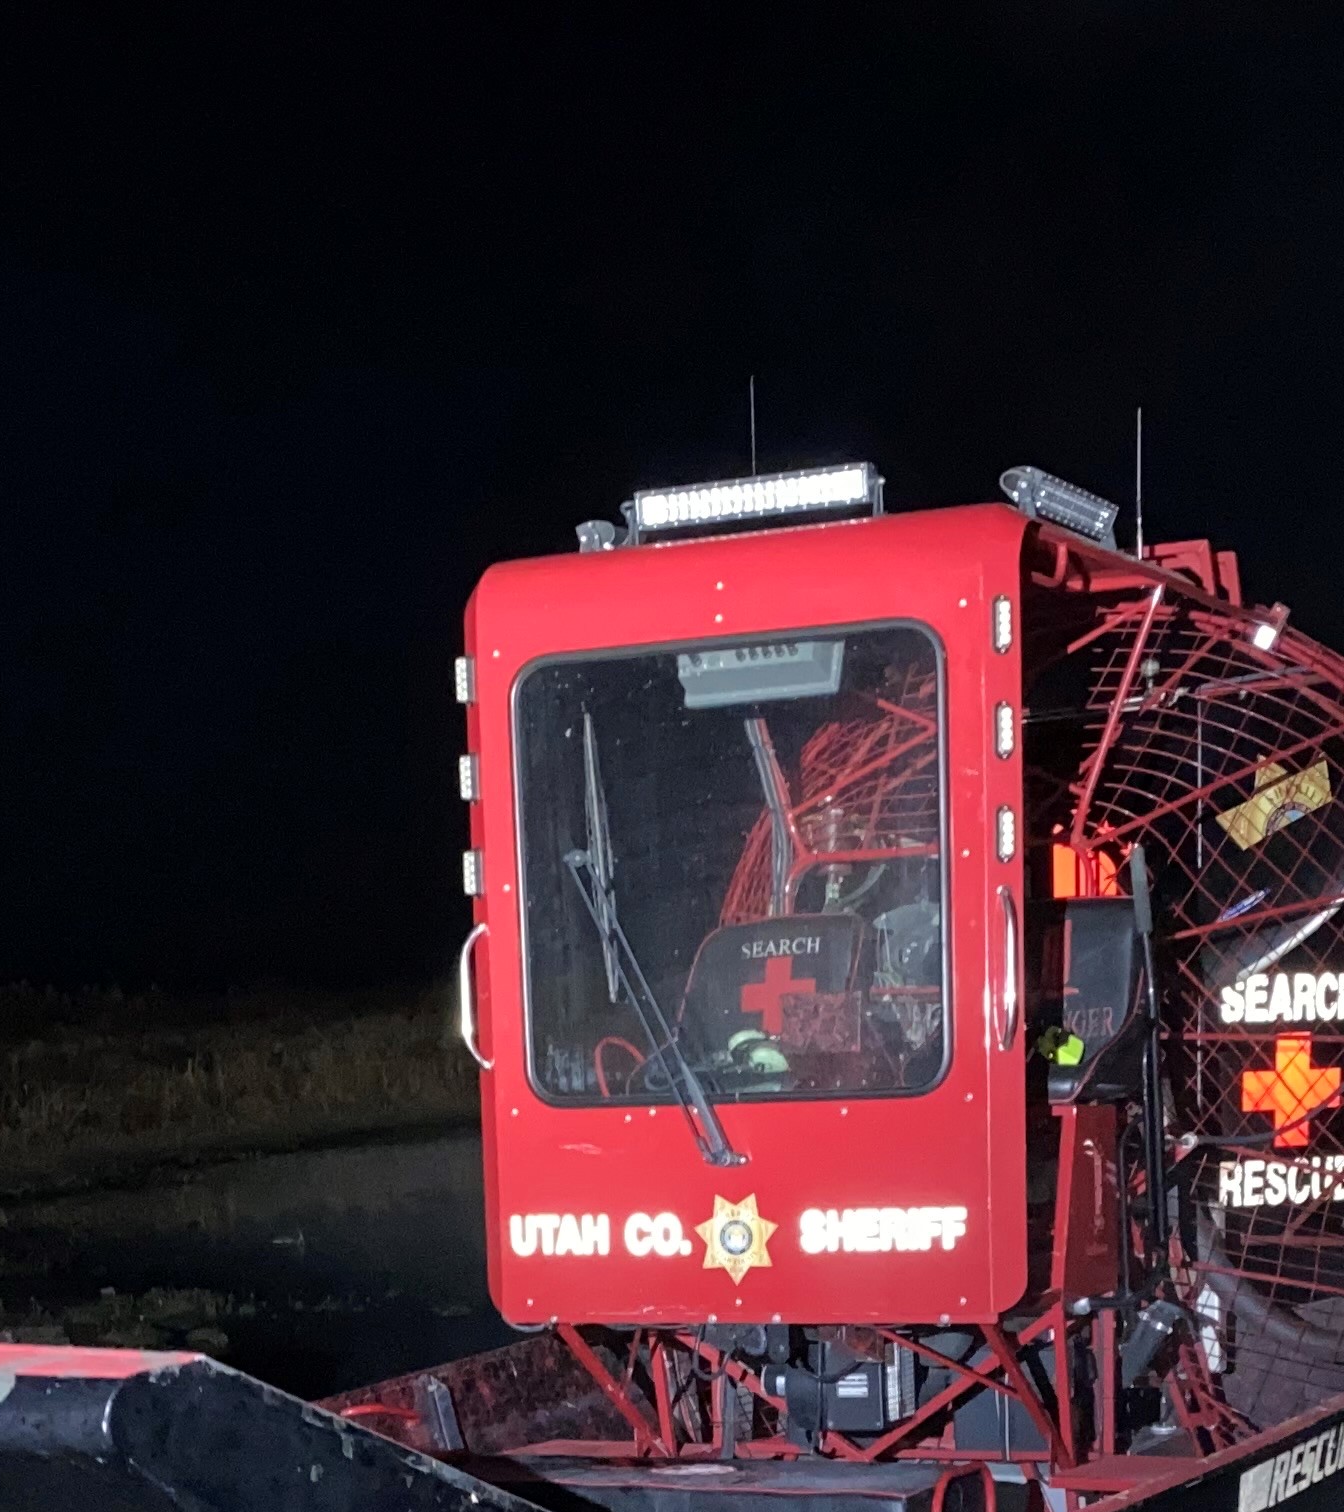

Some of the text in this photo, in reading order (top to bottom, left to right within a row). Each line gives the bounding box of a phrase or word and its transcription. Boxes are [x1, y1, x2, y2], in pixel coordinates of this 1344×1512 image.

[741, 936, 821, 959] SEARCH
[509, 1205, 968, 1257] UTAH CO. SHERIFF
